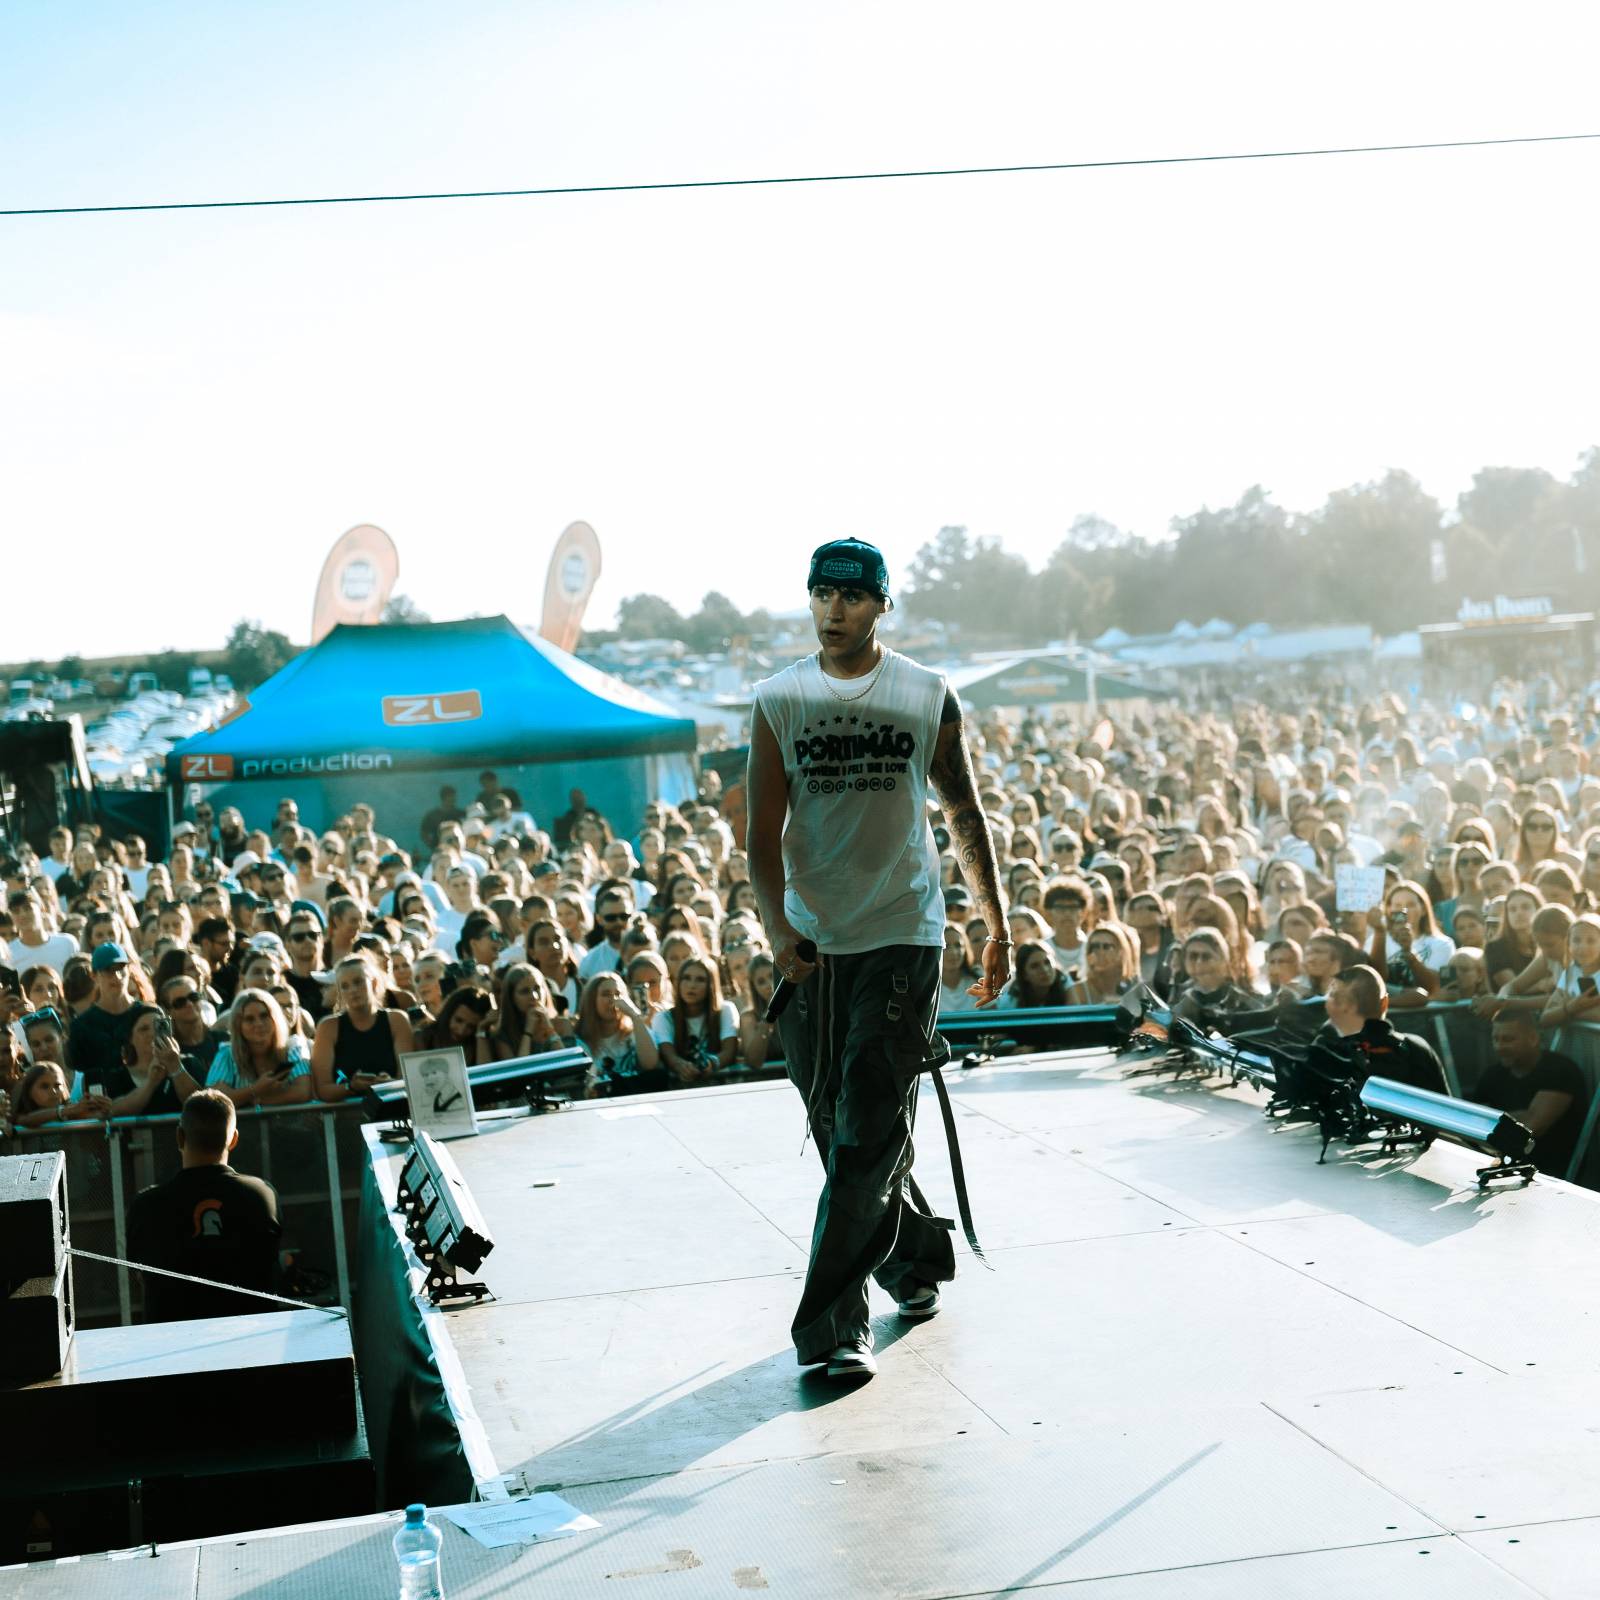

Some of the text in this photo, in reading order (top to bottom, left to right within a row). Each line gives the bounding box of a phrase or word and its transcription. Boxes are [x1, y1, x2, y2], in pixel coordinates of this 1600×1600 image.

[392, 697, 472, 722] ZL
[186, 752, 394, 777] ZL production
